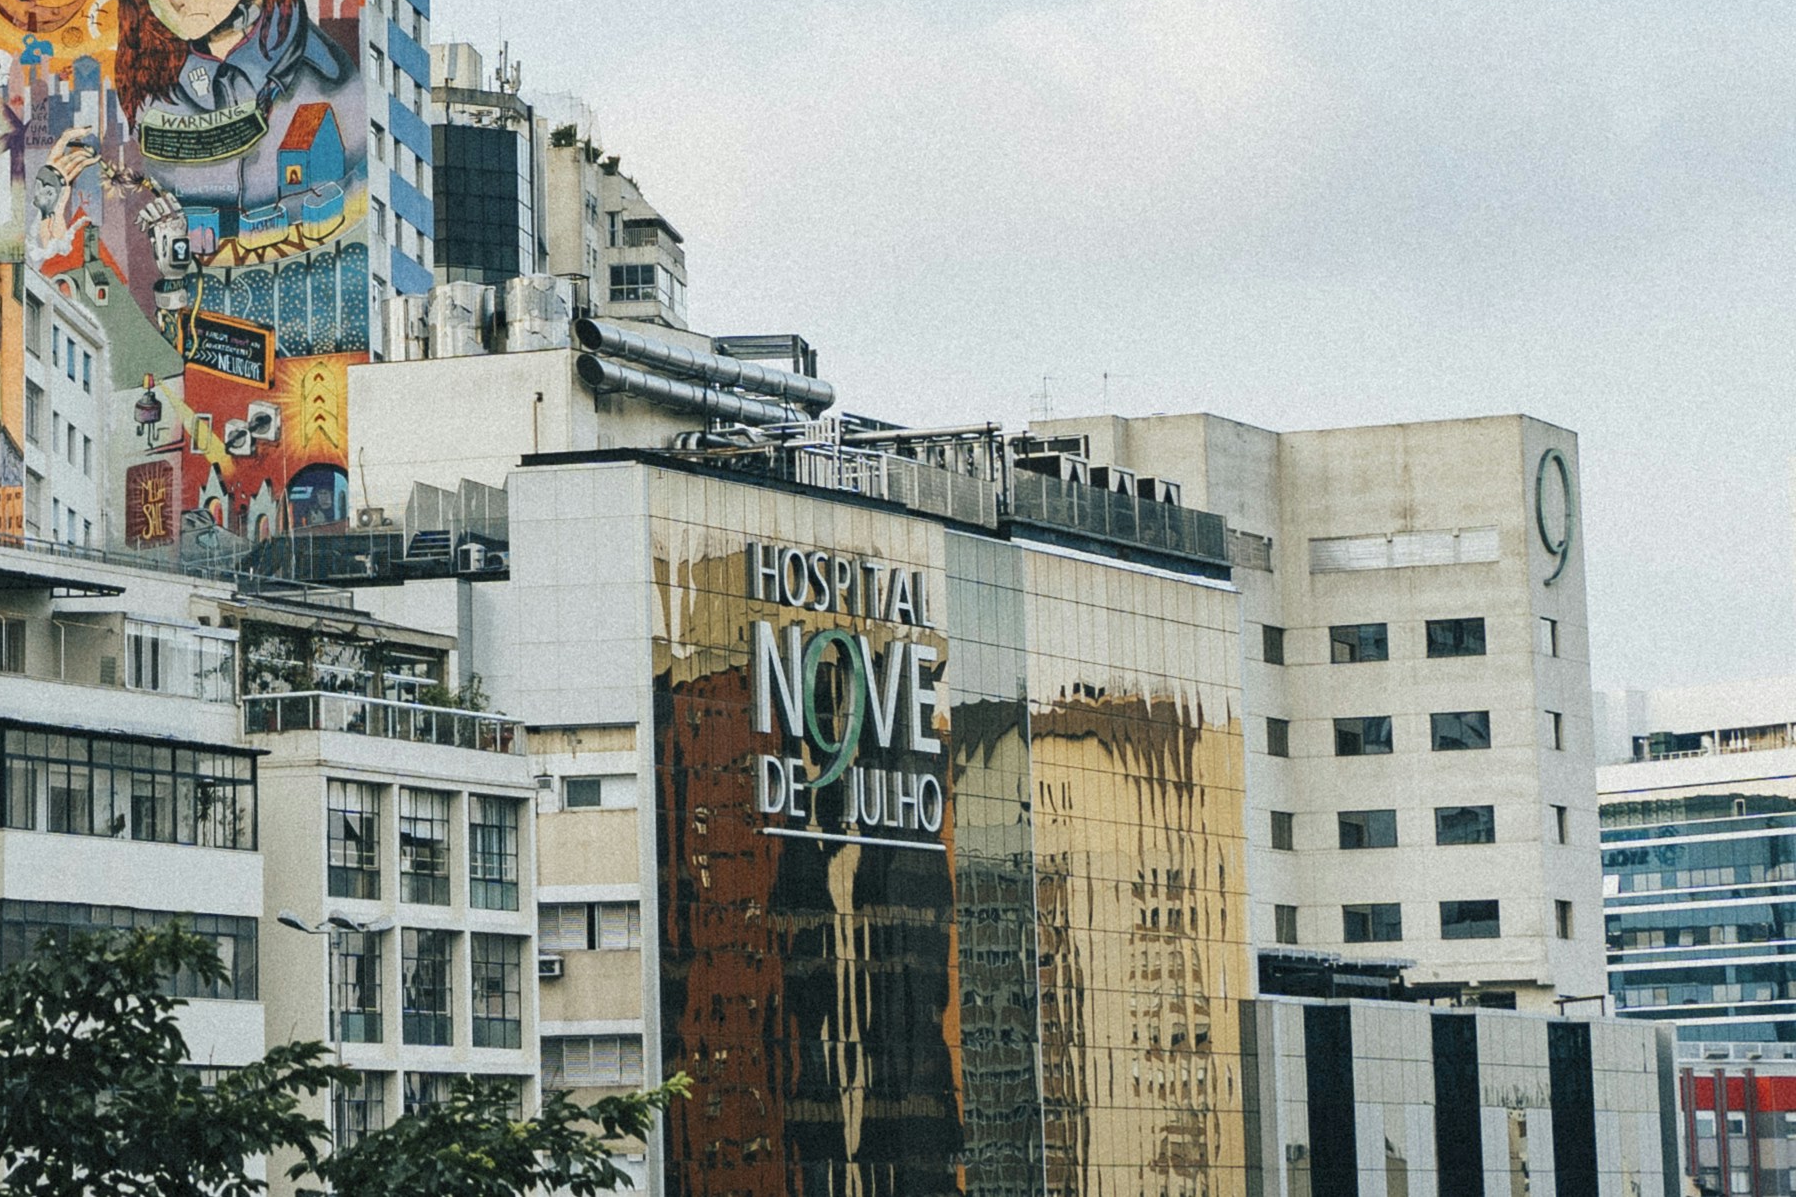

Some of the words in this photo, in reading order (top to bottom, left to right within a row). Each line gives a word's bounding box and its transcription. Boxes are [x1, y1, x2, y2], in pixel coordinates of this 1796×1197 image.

[161, 107, 247, 128] WARNING
[1535, 448, 1574, 586] 9
[748, 541, 937, 630] HOSPITAL
[759, 755, 806, 818] DE
[844, 771, 943, 834] JULHO
